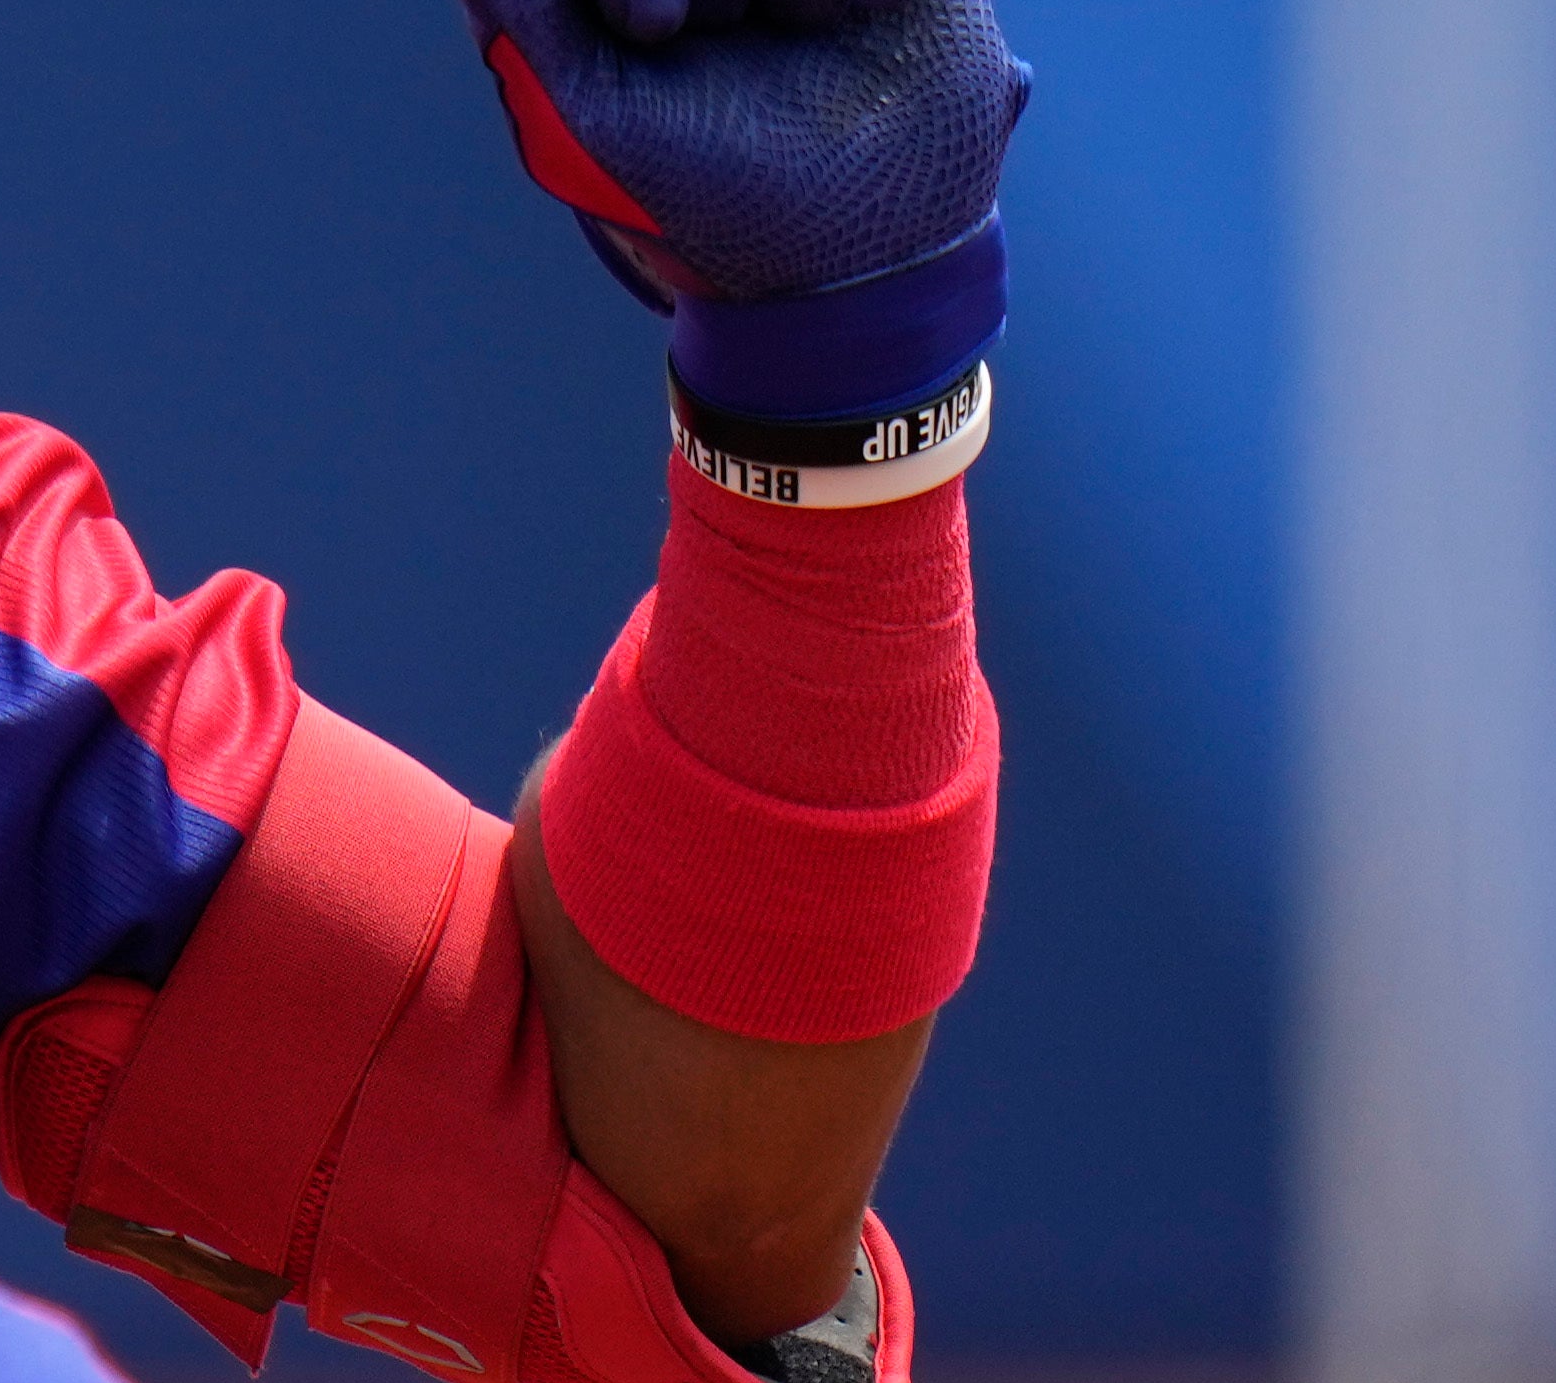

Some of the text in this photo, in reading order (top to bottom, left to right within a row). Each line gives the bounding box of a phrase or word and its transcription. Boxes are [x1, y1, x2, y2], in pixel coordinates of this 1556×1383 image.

[862, 418, 909, 463] UP
[918, 385, 971, 450] GIVE
[675, 426, 800, 505] BELIEVE
